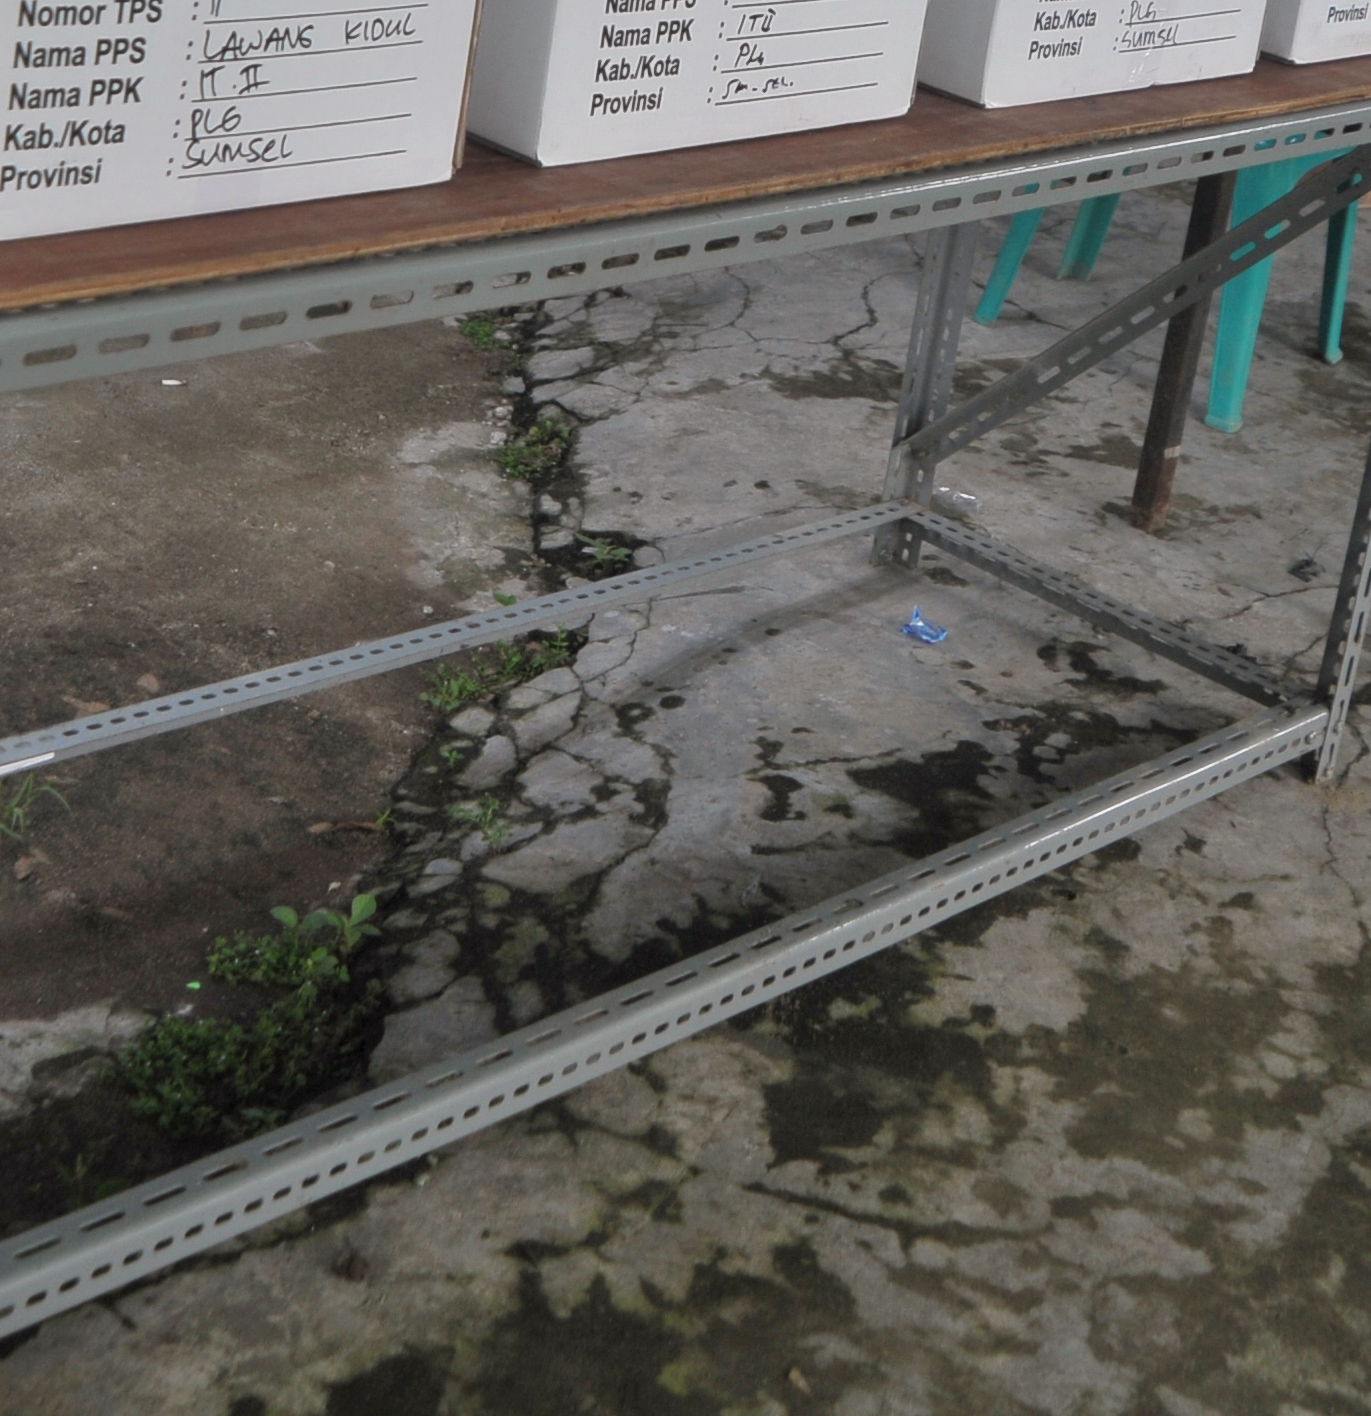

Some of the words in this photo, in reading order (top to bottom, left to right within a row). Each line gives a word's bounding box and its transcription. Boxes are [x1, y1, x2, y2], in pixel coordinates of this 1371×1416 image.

[18, 0, 106, 27] Nomor
[1033, 9, 1097, 32] Kab./Kota
[1327, 3, 1369, 23] Provinsi
[203, 25, 315, 61] LAWANG
[344, 13, 416, 43] KIDUL
[600, 24, 651, 49] Nama
[655, 19, 694, 45] PPK
[1028, 37, 1084, 61] Provinsi
[13, 41, 86, 69] Nama
[94, 37, 146, 66] PPS
[595, 55, 681, 83] Kab./Kota
[8, 83, 82, 110] Nama
[87, 76, 144, 106] PPK
[590, 87, 663, 117] Provinsi
[4, 121, 125, 151] Kab./Kota
[0, 158, 102, 192] Provinsi
